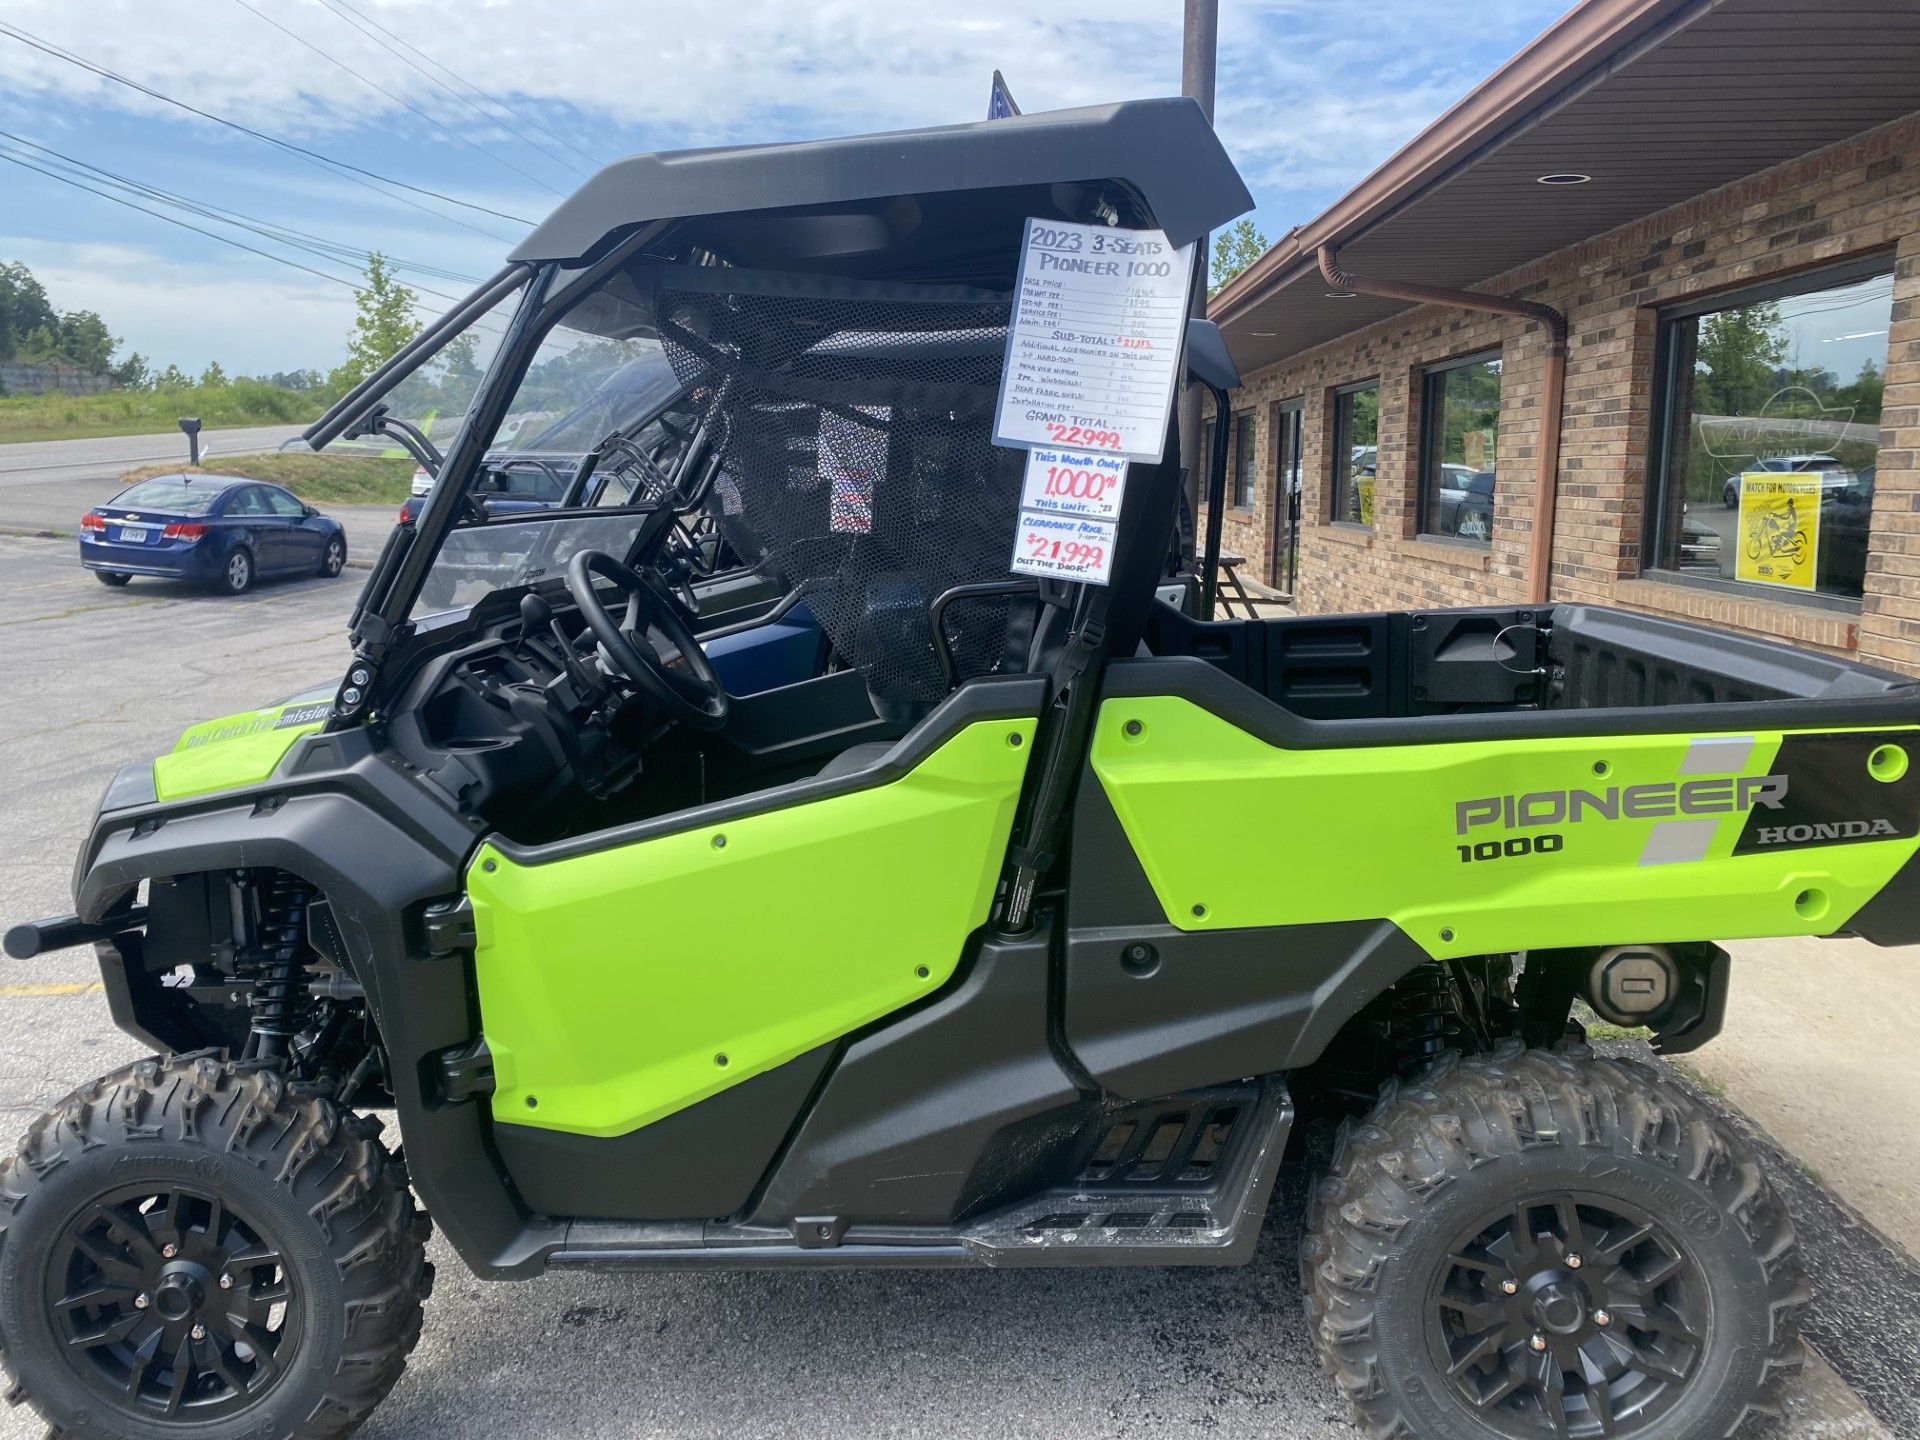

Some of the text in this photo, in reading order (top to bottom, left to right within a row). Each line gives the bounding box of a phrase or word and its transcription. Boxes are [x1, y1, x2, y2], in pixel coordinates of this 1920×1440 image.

[1030, 227, 1162, 255] 2023 3-SEATS
[1040, 252, 1171, 277] PIONEER 1000
[1024, 277, 1040, 286] BASE
[1014, 384, 1034, 392] REAR
[1026, 409, 1066, 423] GRAND
[1746, 482, 1816, 495] WATCH FOR MOTORCYCLES
[1023, 517, 1077, 532] CLEARANCE
[1016, 557, 1035, 566] OUT
[1036, 559, 1055, 569] THE
[1057, 562, 1090, 573] DOOR!
[1455, 774, 1789, 835] PIONEER
[1756, 818, 1899, 845] HONDA
[1456, 834, 1563, 863] 1000
